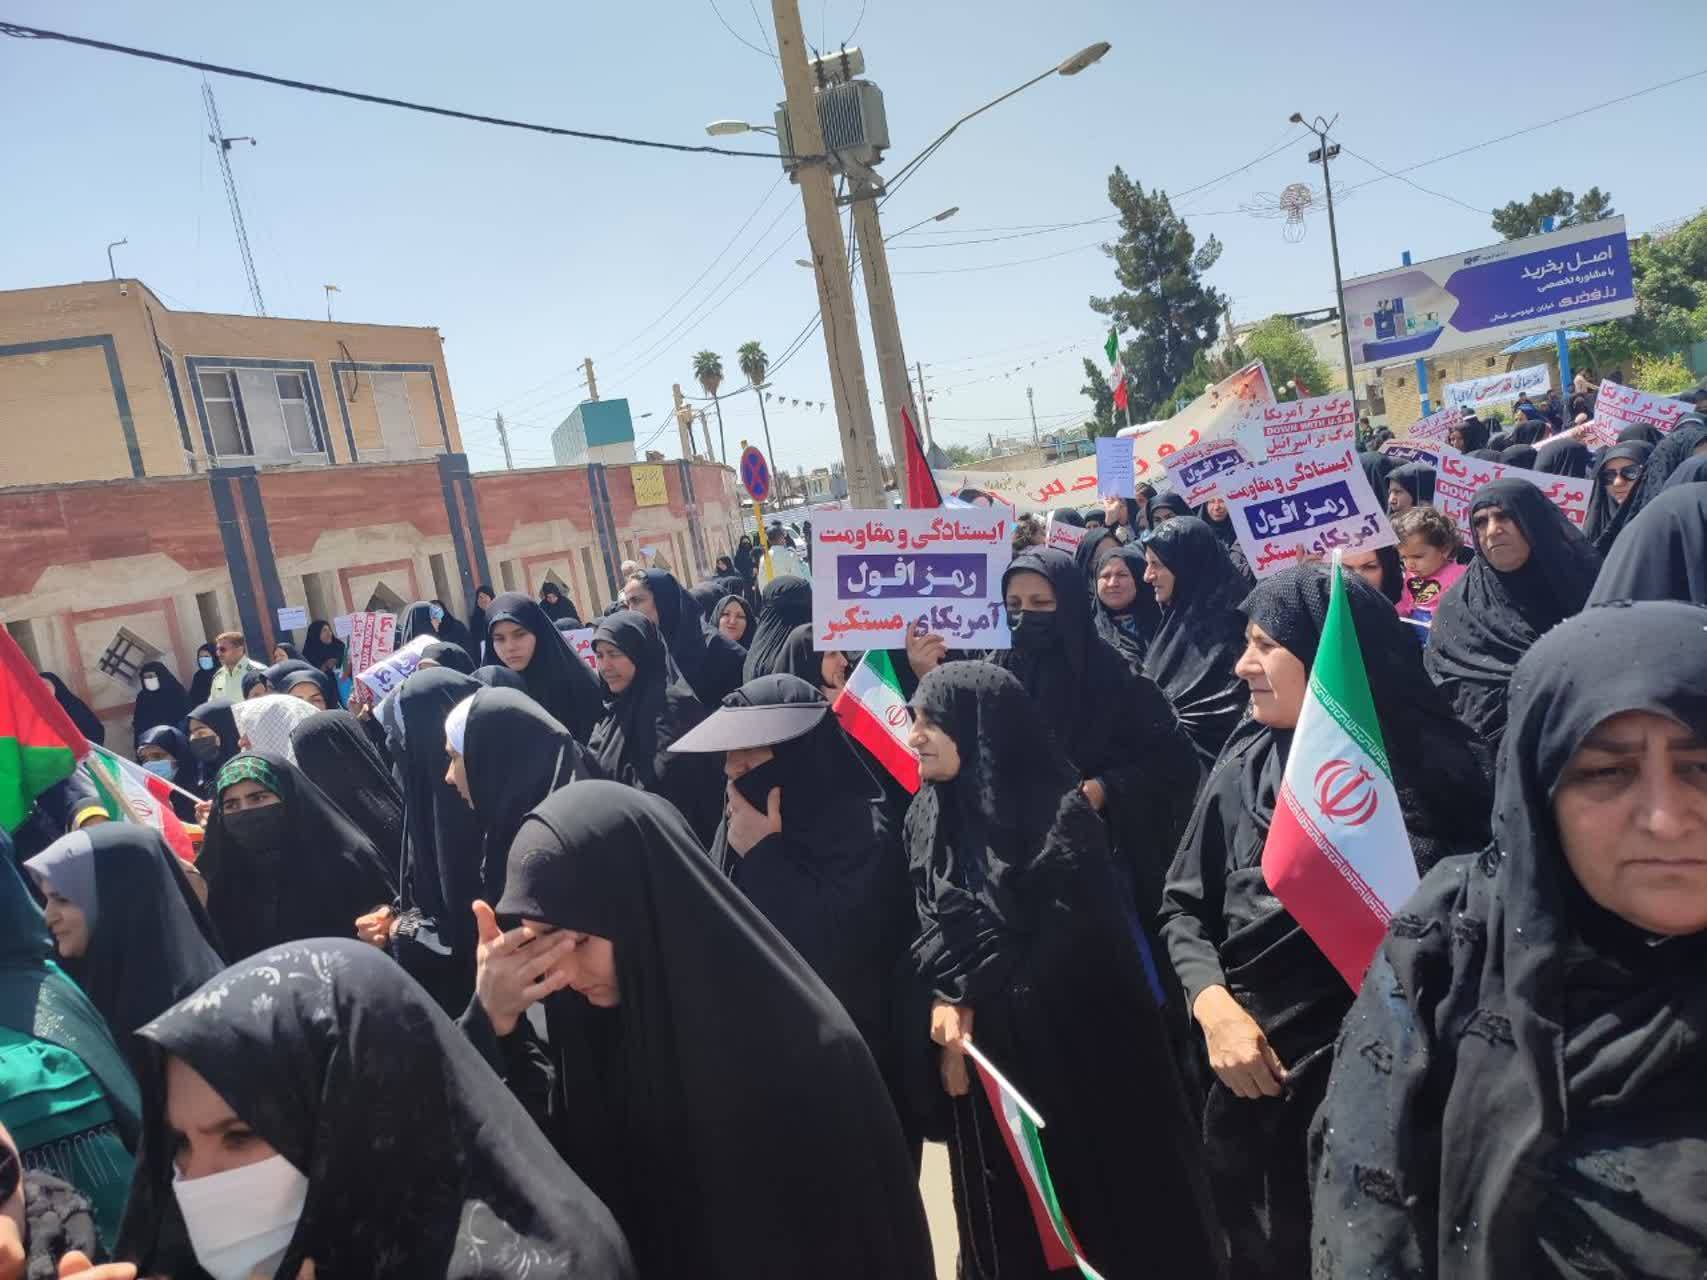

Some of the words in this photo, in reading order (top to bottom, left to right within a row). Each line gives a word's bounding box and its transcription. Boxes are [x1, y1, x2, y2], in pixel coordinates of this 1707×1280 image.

[1520, 259, 1565, 279] بخرید
[1566, 244, 1612, 272] اصل
[1575, 269, 1607, 284] مشاوره
[1264, 401, 1303, 423] آمریکا
[1309, 405, 1320, 419] بر
[1325, 399, 1351, 413] مرگ
[1266, 424, 1299, 435] DOWN
[1186, 459, 1214, 483] افول
[1285, 450, 1354, 489] ایستادگی
[1442, 456, 1506, 487] آمریکا
[1226, 477, 1274, 500] مقاومت
[1275, 477, 1285, 494] و
[1439, 481, 1476, 500] DOW
[1255, 499, 1300, 534] افول
[1304, 497, 1349, 526] رمز
[819, 521, 894, 550] مقاومت
[898, 529, 908, 549] و
[911, 518, 1005, 550] ایستادگی
[847, 557, 916, 597] افول
[916, 565, 977, 596] رمز
[821, 605, 904, 641] مستکبر
[908, 602, 1005, 639] آمریکای
